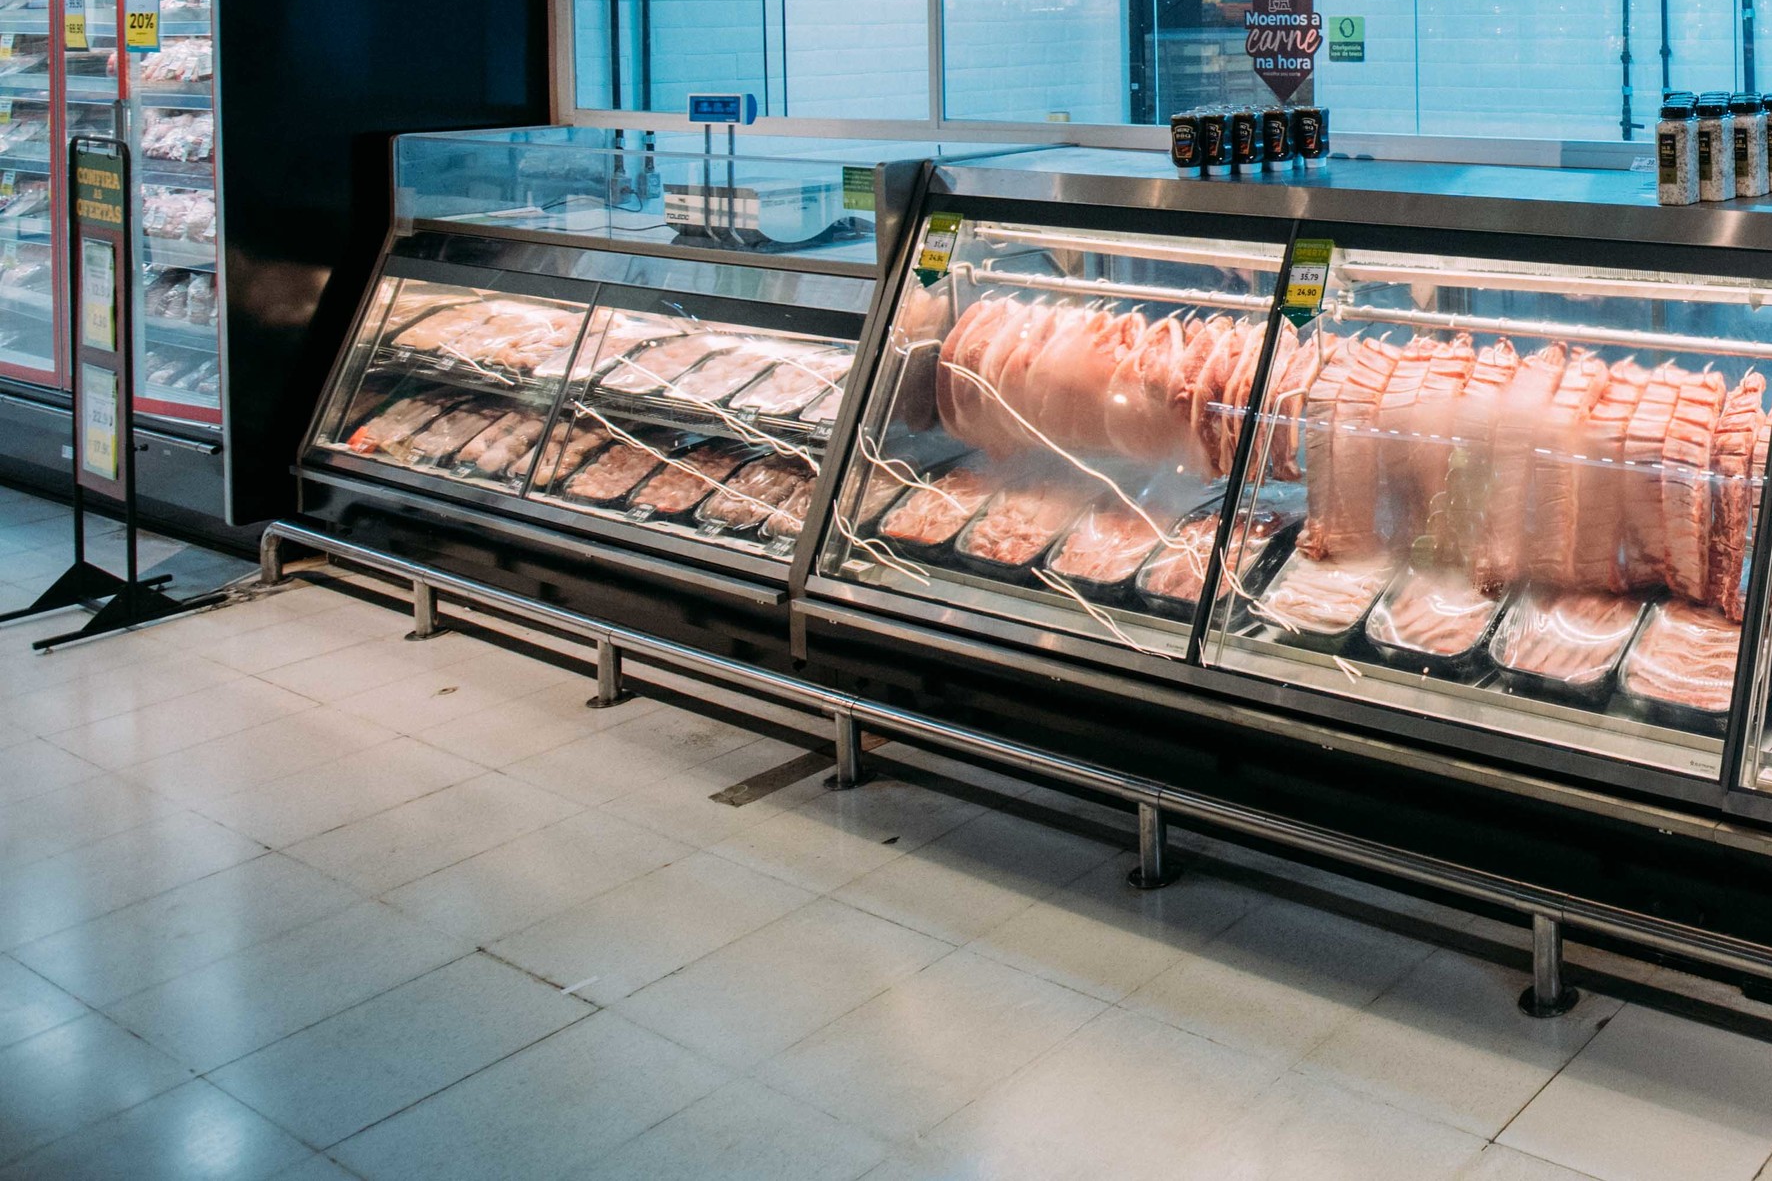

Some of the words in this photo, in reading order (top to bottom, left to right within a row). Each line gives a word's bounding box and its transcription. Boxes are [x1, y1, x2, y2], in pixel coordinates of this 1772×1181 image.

[130, 13, 154, 28] 20%
[1246, 12, 1308, 25] Moemos
[1311, 14, 1320, 25] a
[1247, 29, 1321, 53] carne
[1257, 58, 1274, 69] na
[1278, 55, 1311, 69] hora
[77, 167, 120, 190] CONFIRA
[77, 198, 121, 223] OFERTAS
